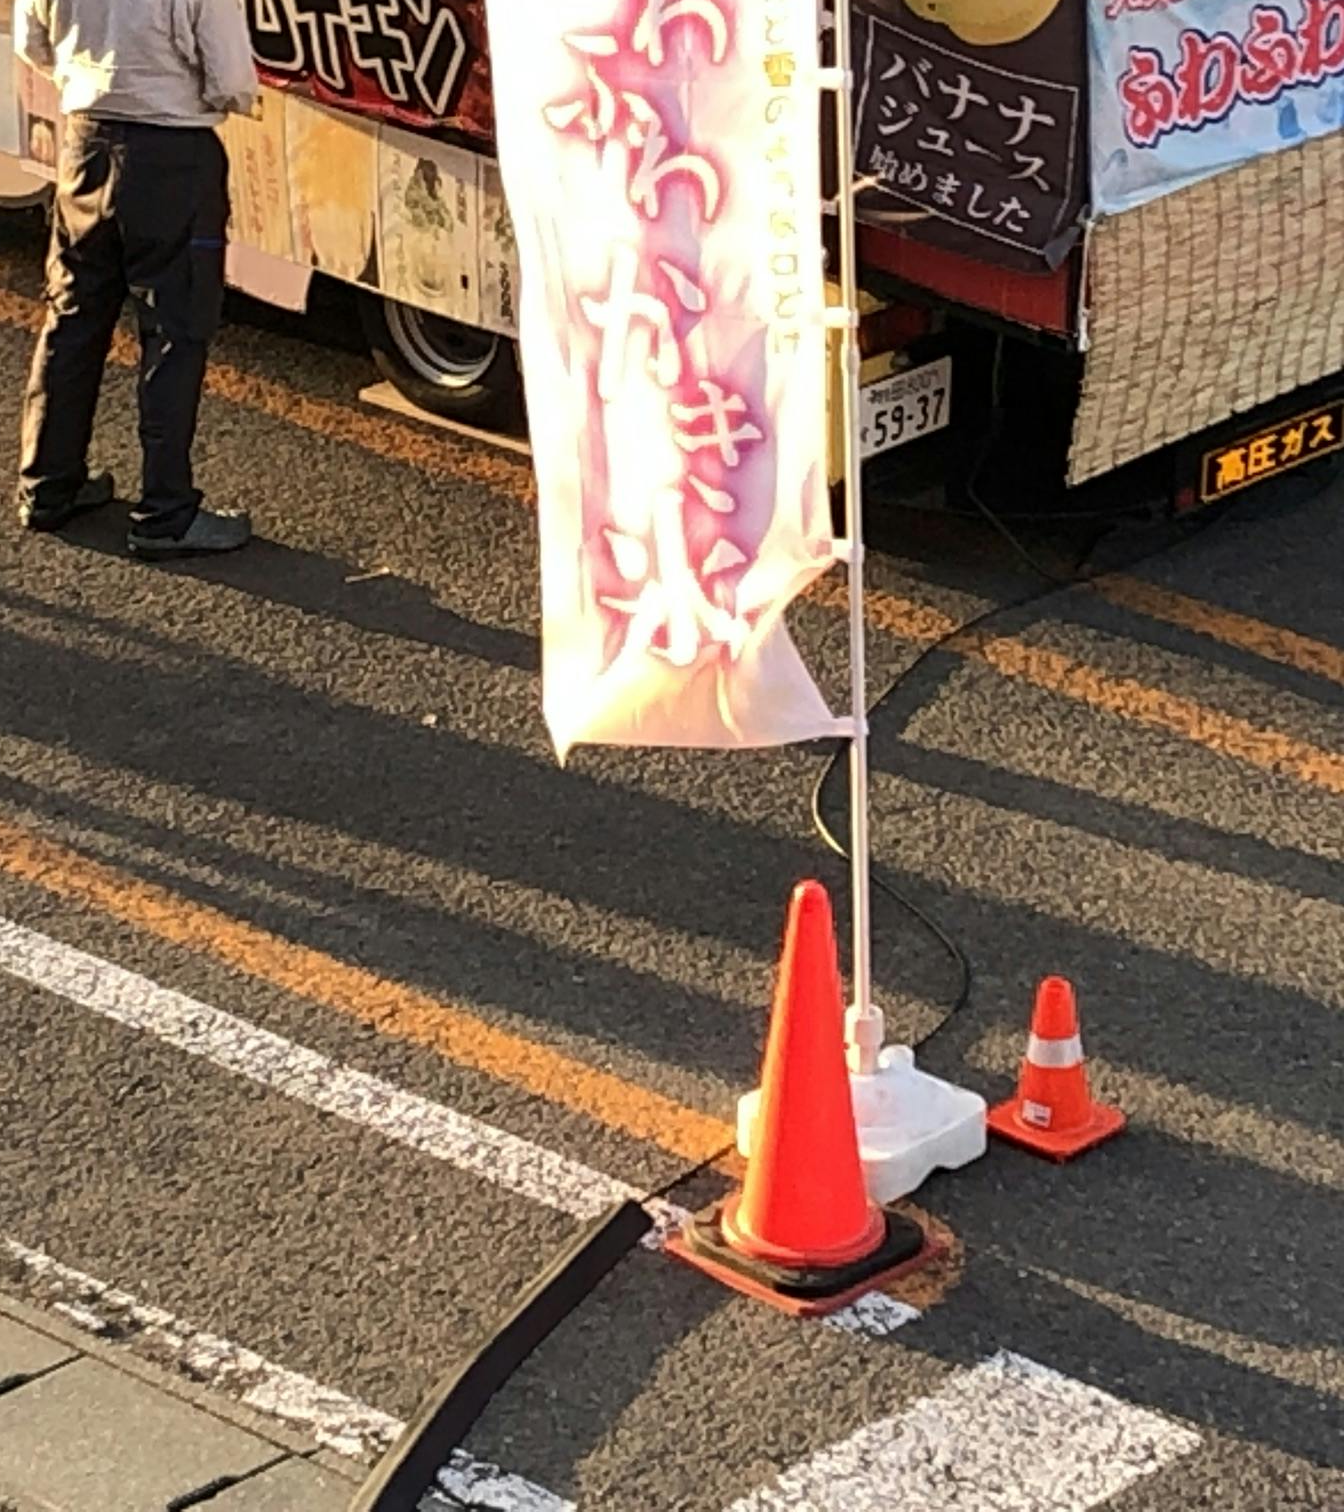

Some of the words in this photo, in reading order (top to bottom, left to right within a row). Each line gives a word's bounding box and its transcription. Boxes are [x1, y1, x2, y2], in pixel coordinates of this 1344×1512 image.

[876, 95, 1051, 192] ジュース
[879, 52, 1056, 146] バナナ
[869, 144, 1034, 234] 始めました
[873, 387, 946, 448] 59-37
[1215, 414, 1335, 490] 高圧ガス
